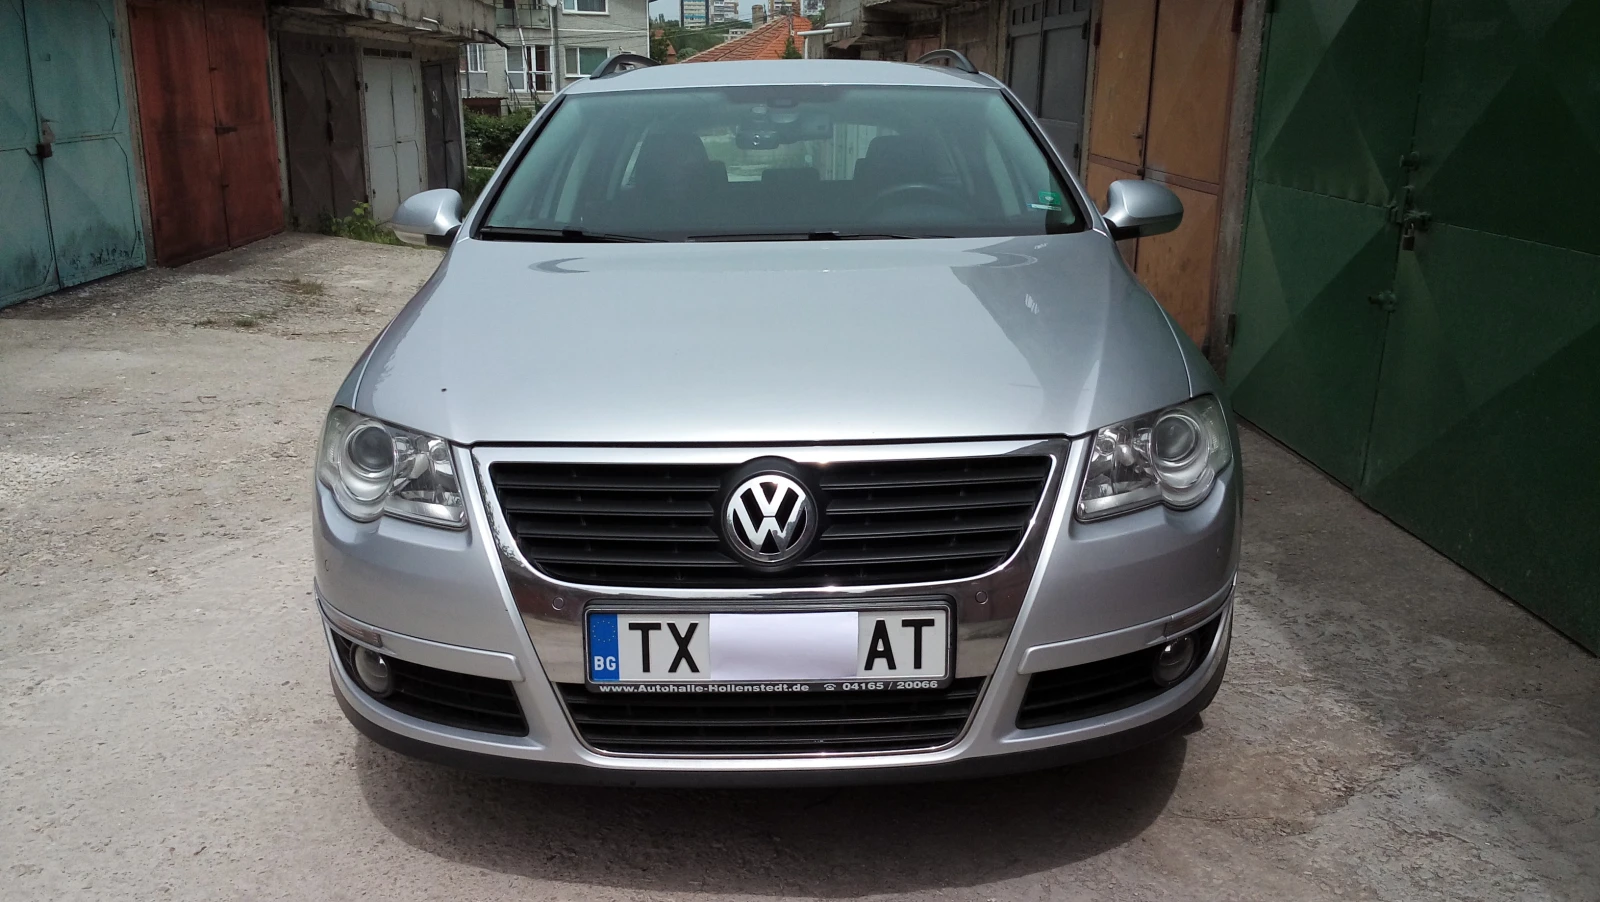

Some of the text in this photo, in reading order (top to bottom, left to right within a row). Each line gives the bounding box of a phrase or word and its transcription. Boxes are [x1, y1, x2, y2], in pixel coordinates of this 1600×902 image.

[727, 474, 810, 562] VW
[594, 655, 617, 671] BG
[628, 619, 935, 673] TX AT
[599, 683, 810, 693] www.Autohalle-Hollenstedt.de
[842, 682, 884, 691] 04165
[896, 680, 938, 690] 20066
